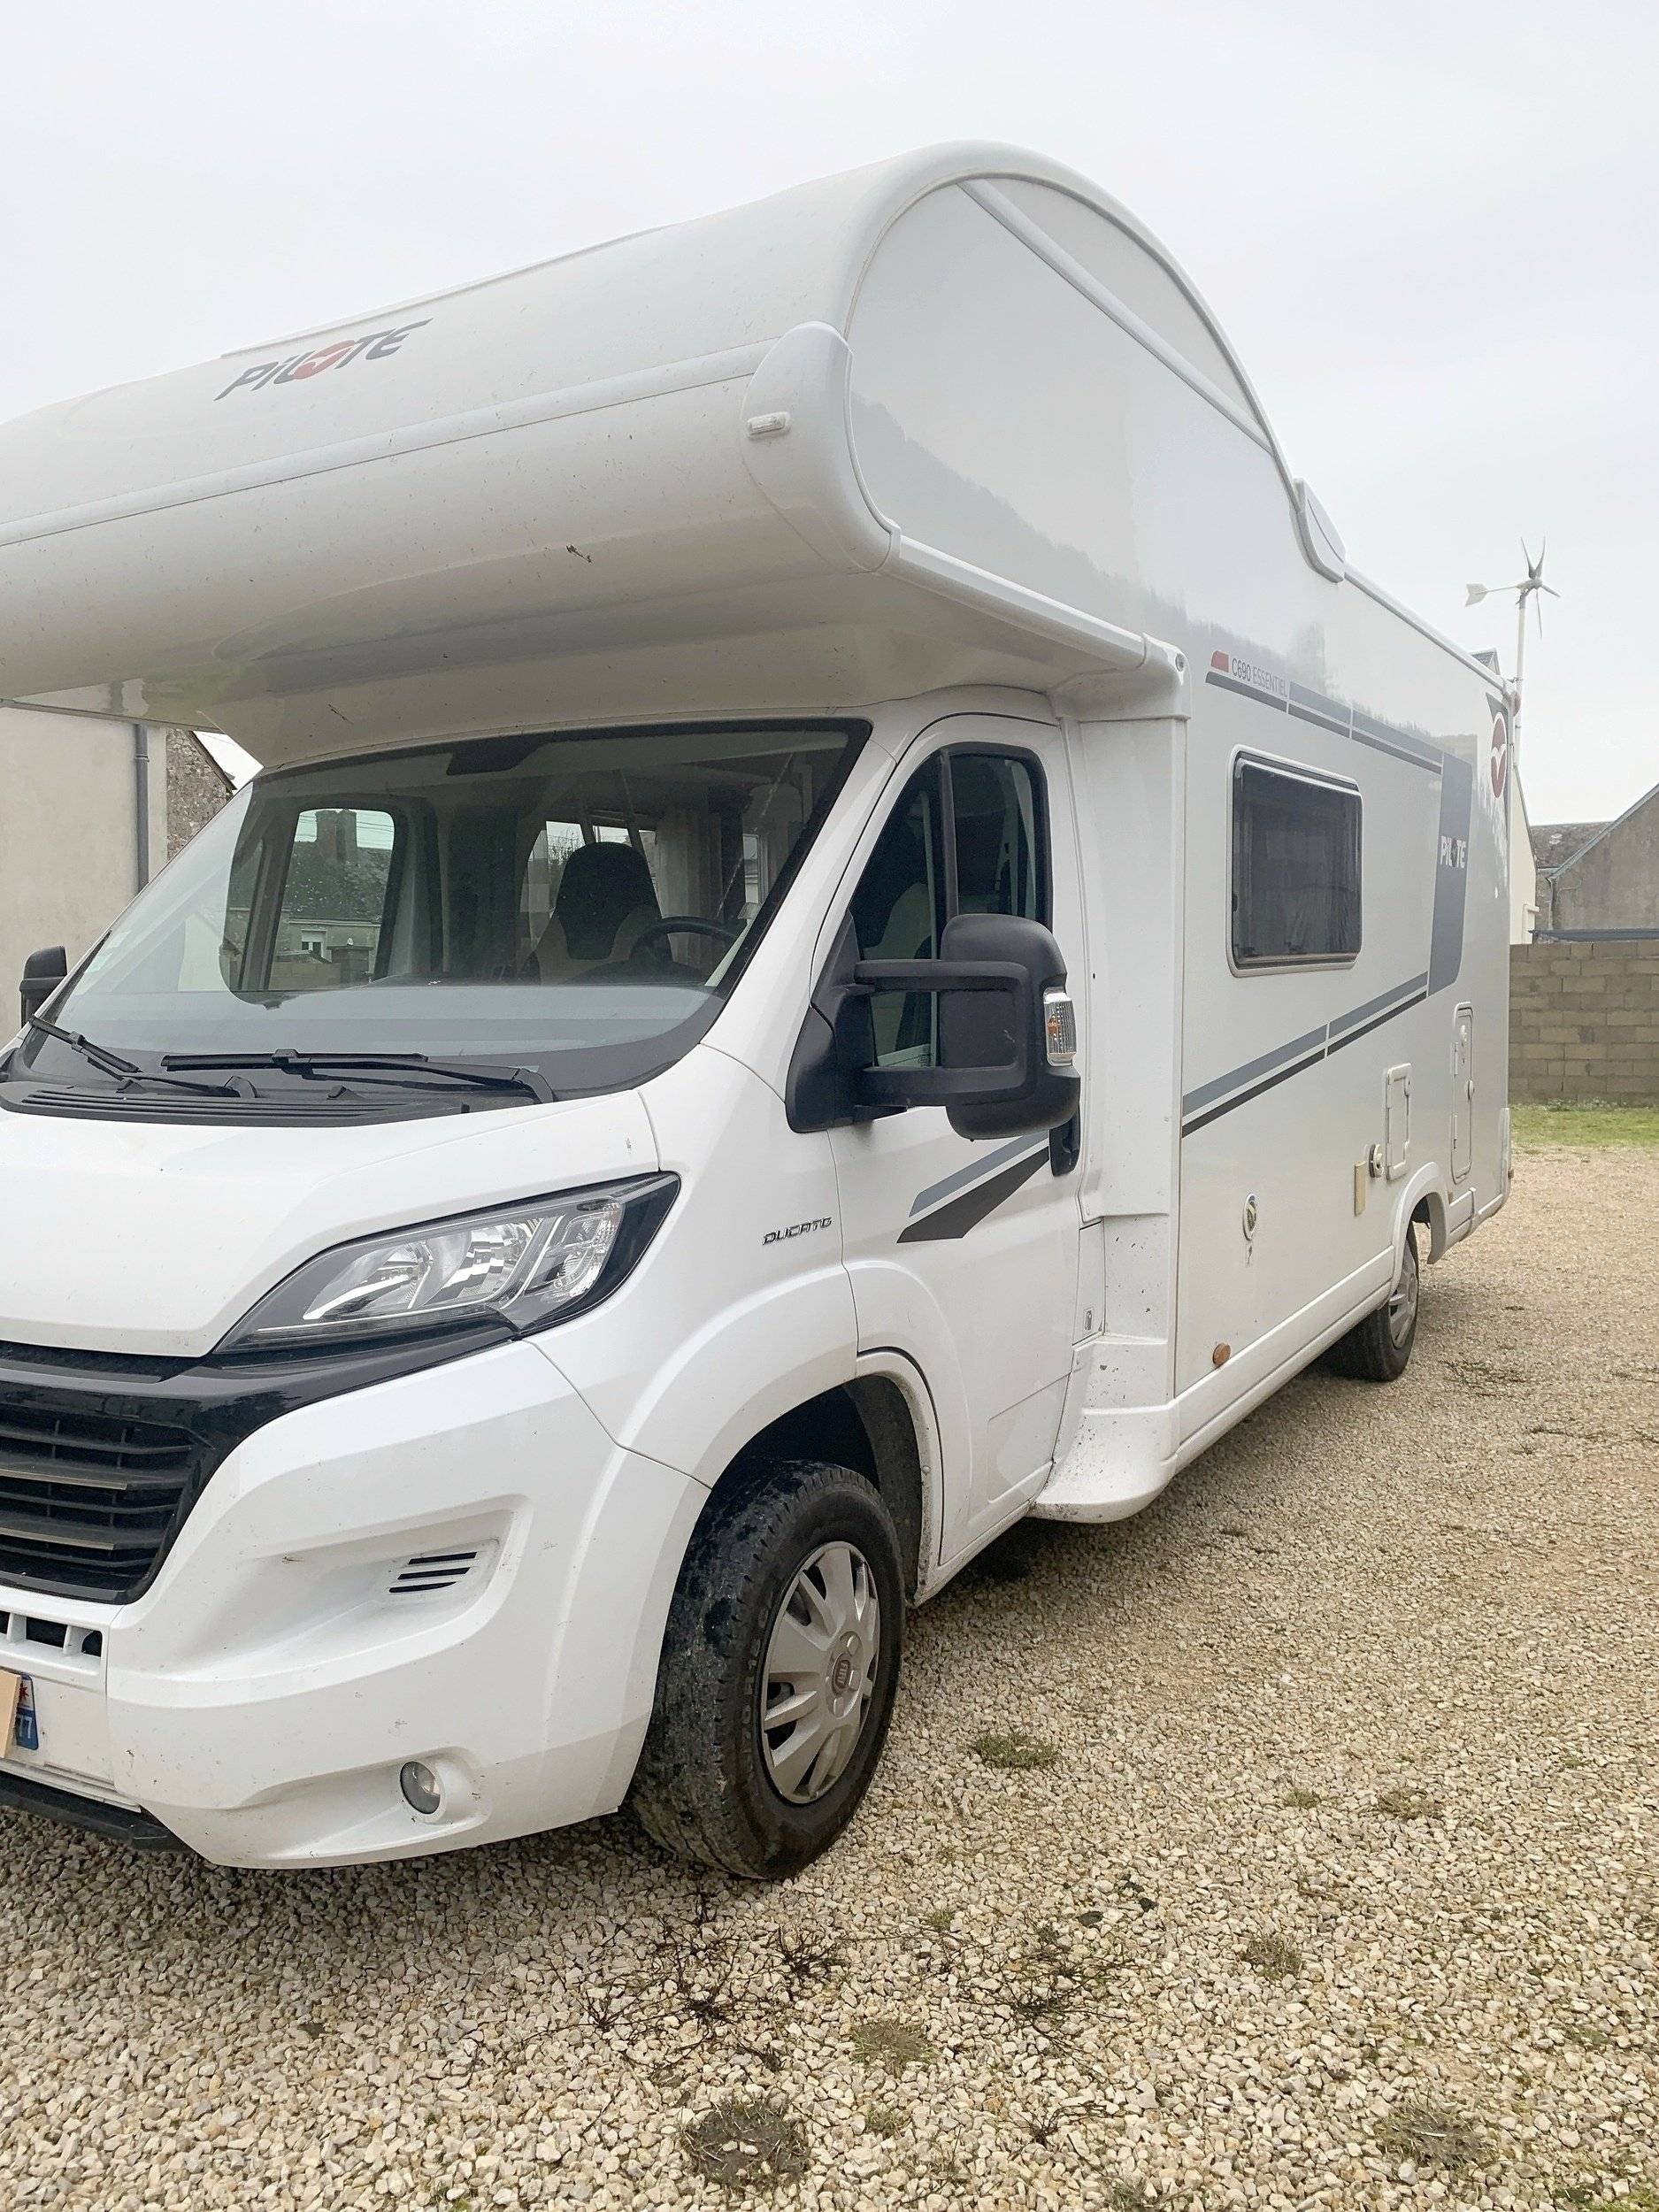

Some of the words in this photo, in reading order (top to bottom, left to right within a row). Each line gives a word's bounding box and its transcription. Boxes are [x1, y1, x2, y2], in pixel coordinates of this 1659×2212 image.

[1232, 657, 1251, 681] C690
[1252, 666, 1287, 697] ESSENTIEL
[763, 1217, 832, 1245] DUCATO
